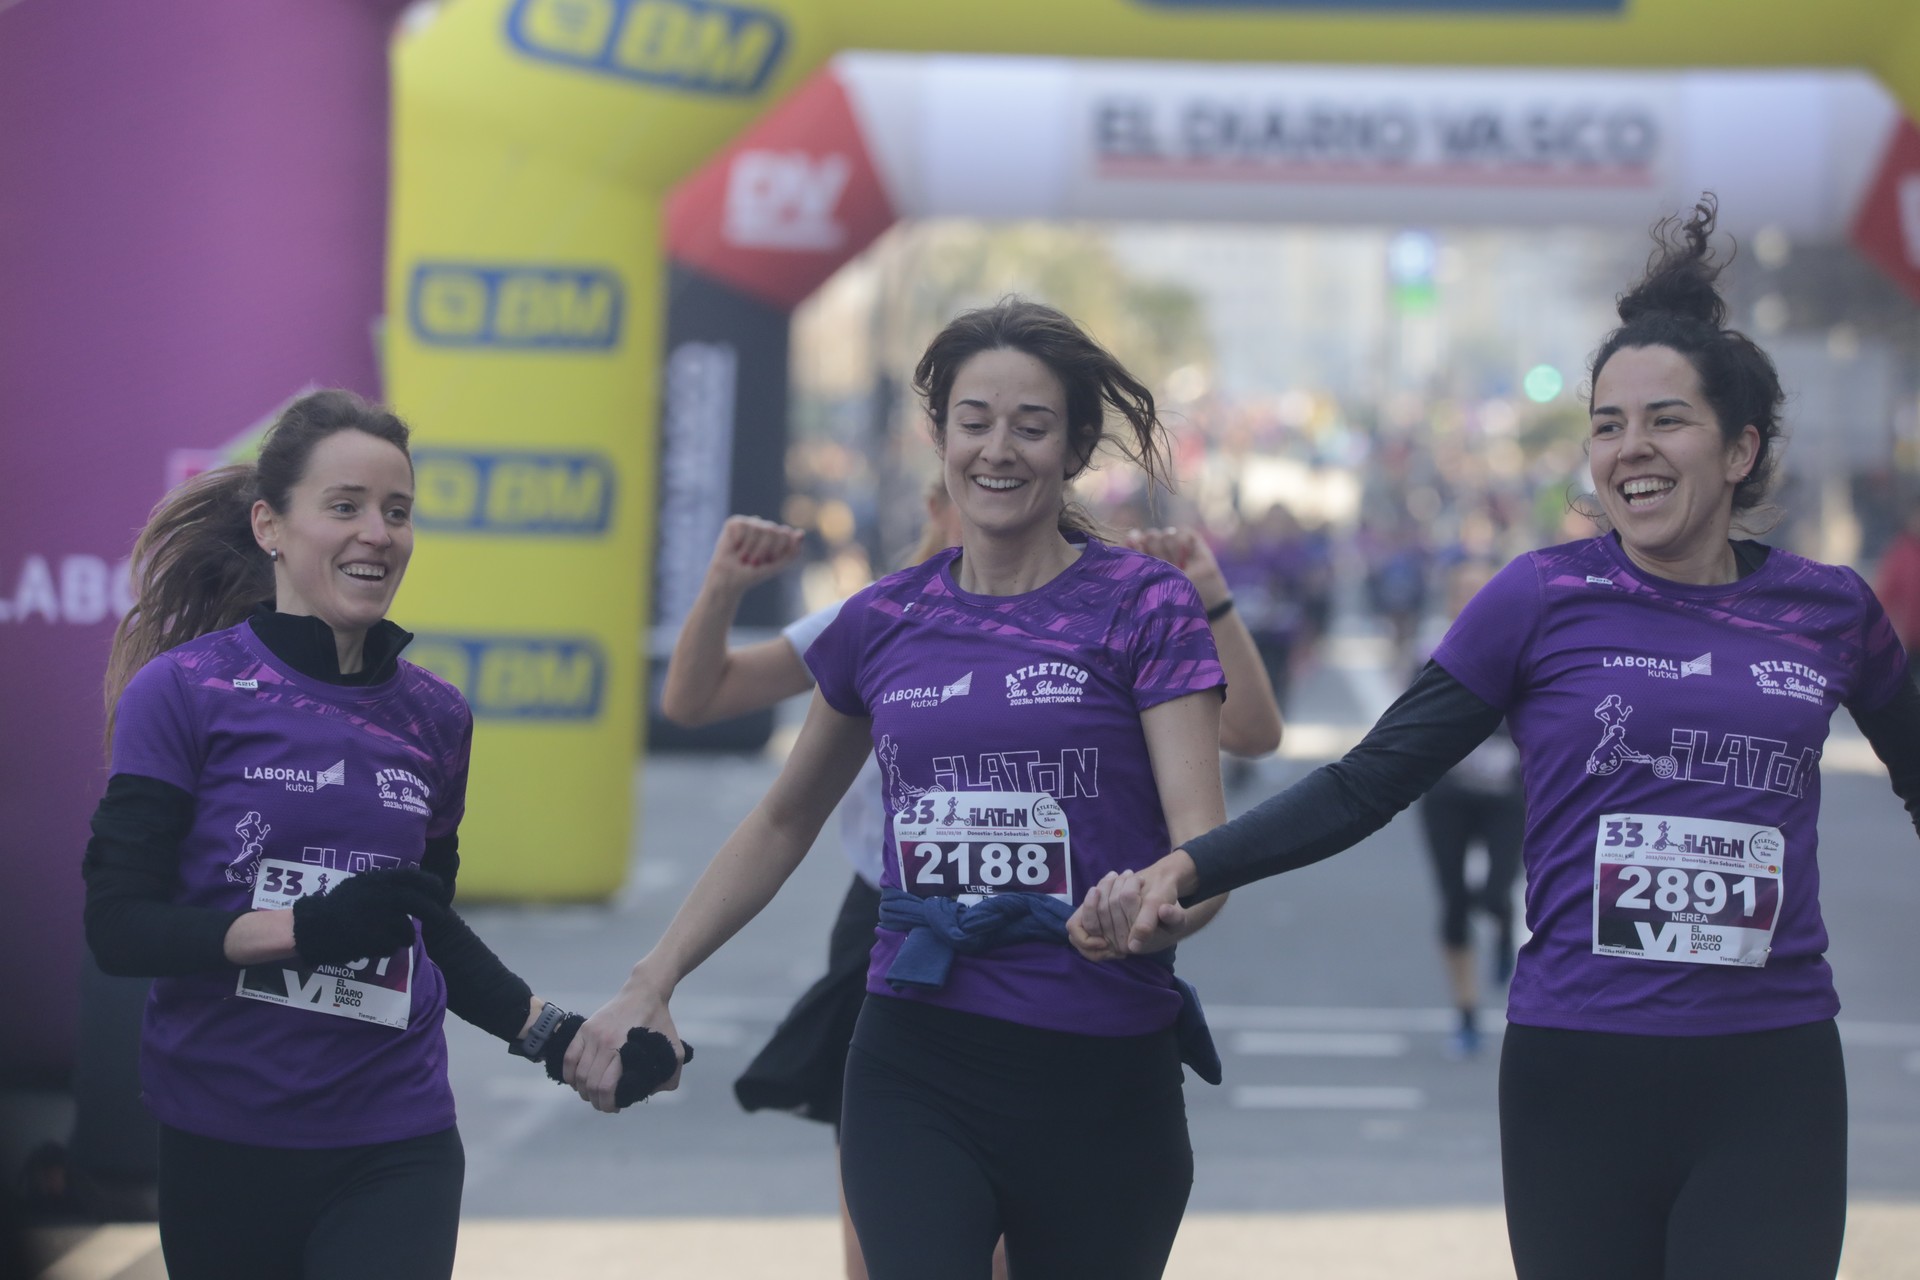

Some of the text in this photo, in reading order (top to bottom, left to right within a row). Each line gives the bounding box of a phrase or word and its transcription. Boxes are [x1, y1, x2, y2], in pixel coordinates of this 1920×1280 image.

[1096, 102, 1658, 168] EL DIARIO VASCO
[1602, 656, 1678, 671] LABORAL
[1005, 662, 1089, 688] ATLETICO
[1648, 669, 1679, 680] kutxa
[1749, 660, 1828, 687] ATLETICO
[1756, 673, 1780, 687] San
[883, 686, 939, 704] LABORAL
[1006, 680, 1083, 699] San Sebastian
[910, 699, 938, 709] kutxa
[1034, 695, 1075, 704] MARTXOAK
[244, 766, 315, 783] LABORAL
[285, 782, 314, 794] kutxa
[375, 768, 430, 799] ATLETICO
[379, 783, 398, 800] San
[914, 842, 1050, 886] 2188
[964, 885, 994, 894] LEIRE
[1615, 866, 1757, 917] 2891
[1671, 912, 1709, 924] NEREA
[1691, 924, 1702, 933] EL
[1690, 933, 1723, 943] DIARIO
[1690, 942, 1721, 951] VASCO
[316, 964, 356, 980] AINHOA
[336, 978, 347, 988] EL
[335, 987, 363, 1000] DIARIO
[334, 995, 361, 1008] VASCO
